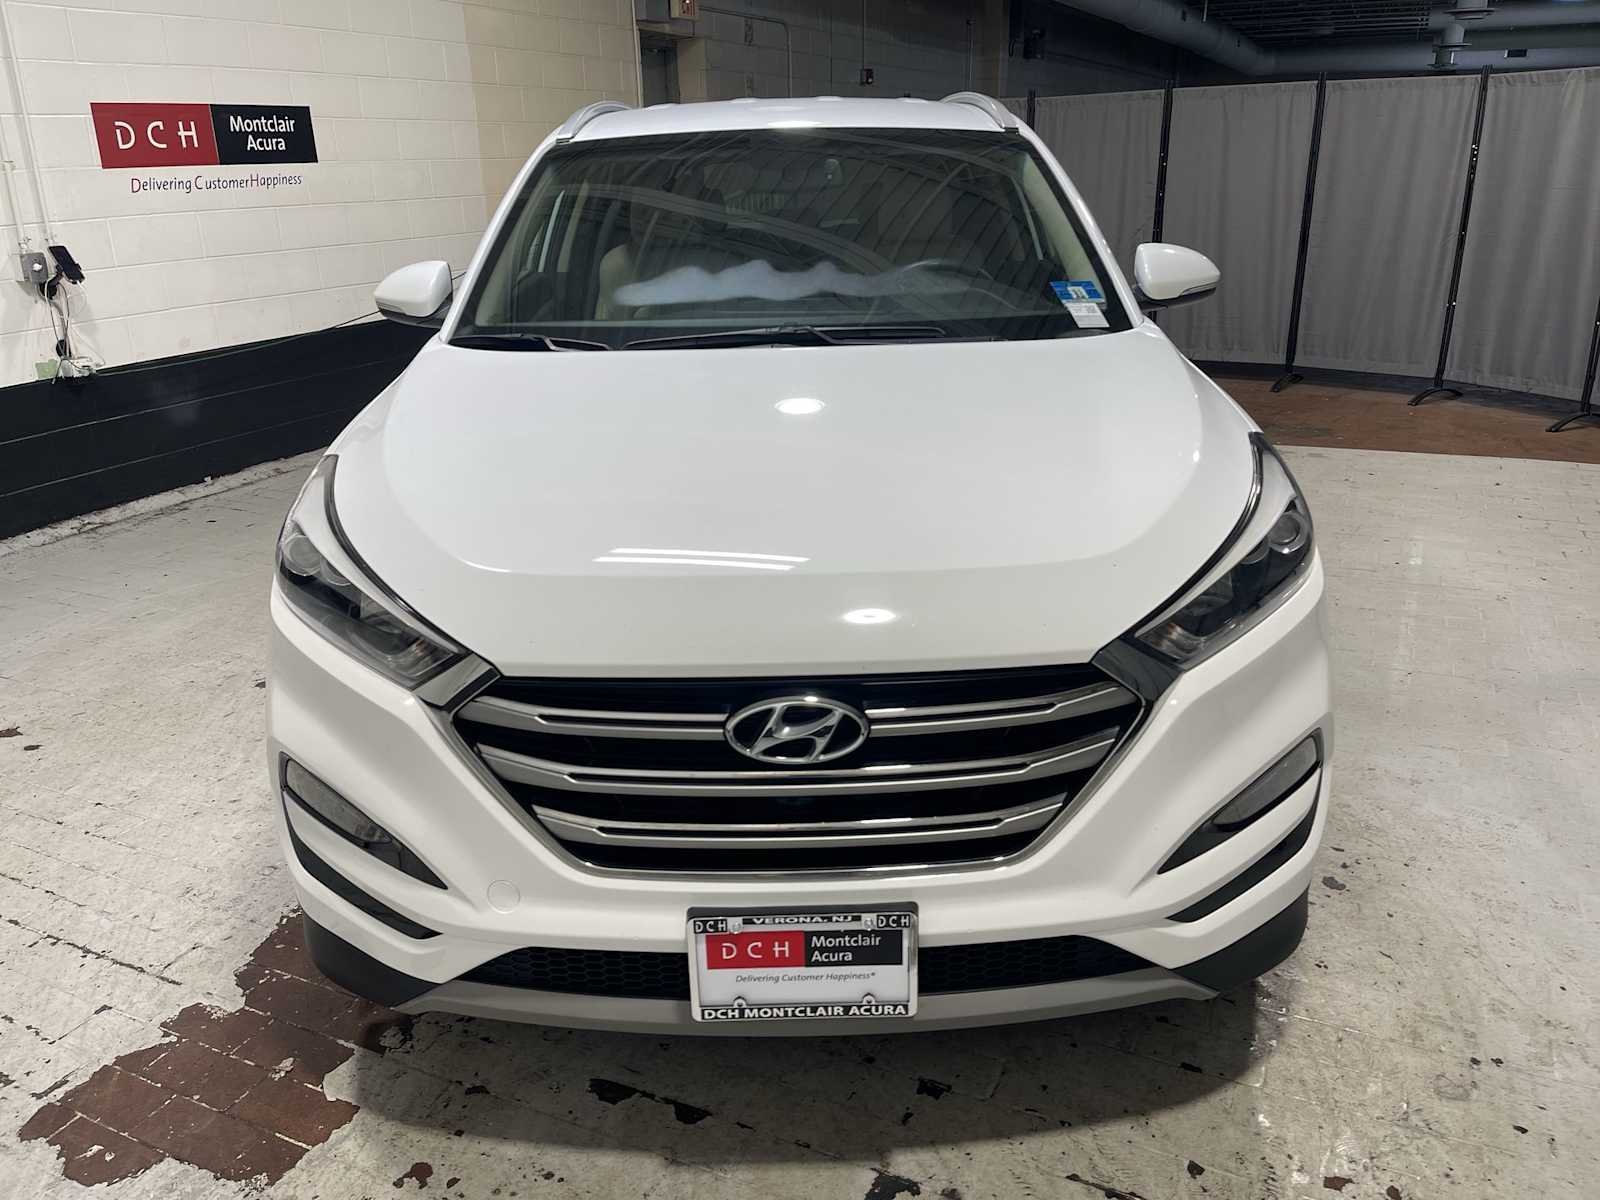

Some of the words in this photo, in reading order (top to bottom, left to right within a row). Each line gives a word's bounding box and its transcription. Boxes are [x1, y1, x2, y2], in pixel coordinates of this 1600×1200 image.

[229, 115, 296, 133] Montclair
[247, 134, 286, 151] Acura
[131, 177, 192, 194] Delivering
[695, 920, 727, 933] DCH
[878, 915, 910, 927] DCH
[811, 934, 881, 947] Montclair
[721, 941, 790, 960] DCH
[811, 950, 852, 962] Acura
[735, 974, 780, 984] Delivering
[781, 973, 824, 982] Customer
[704, 1008, 740, 1020] DCH
[744, 1006, 844, 1018] MONTCLAIR
[849, 1005, 907, 1016] ACURA
